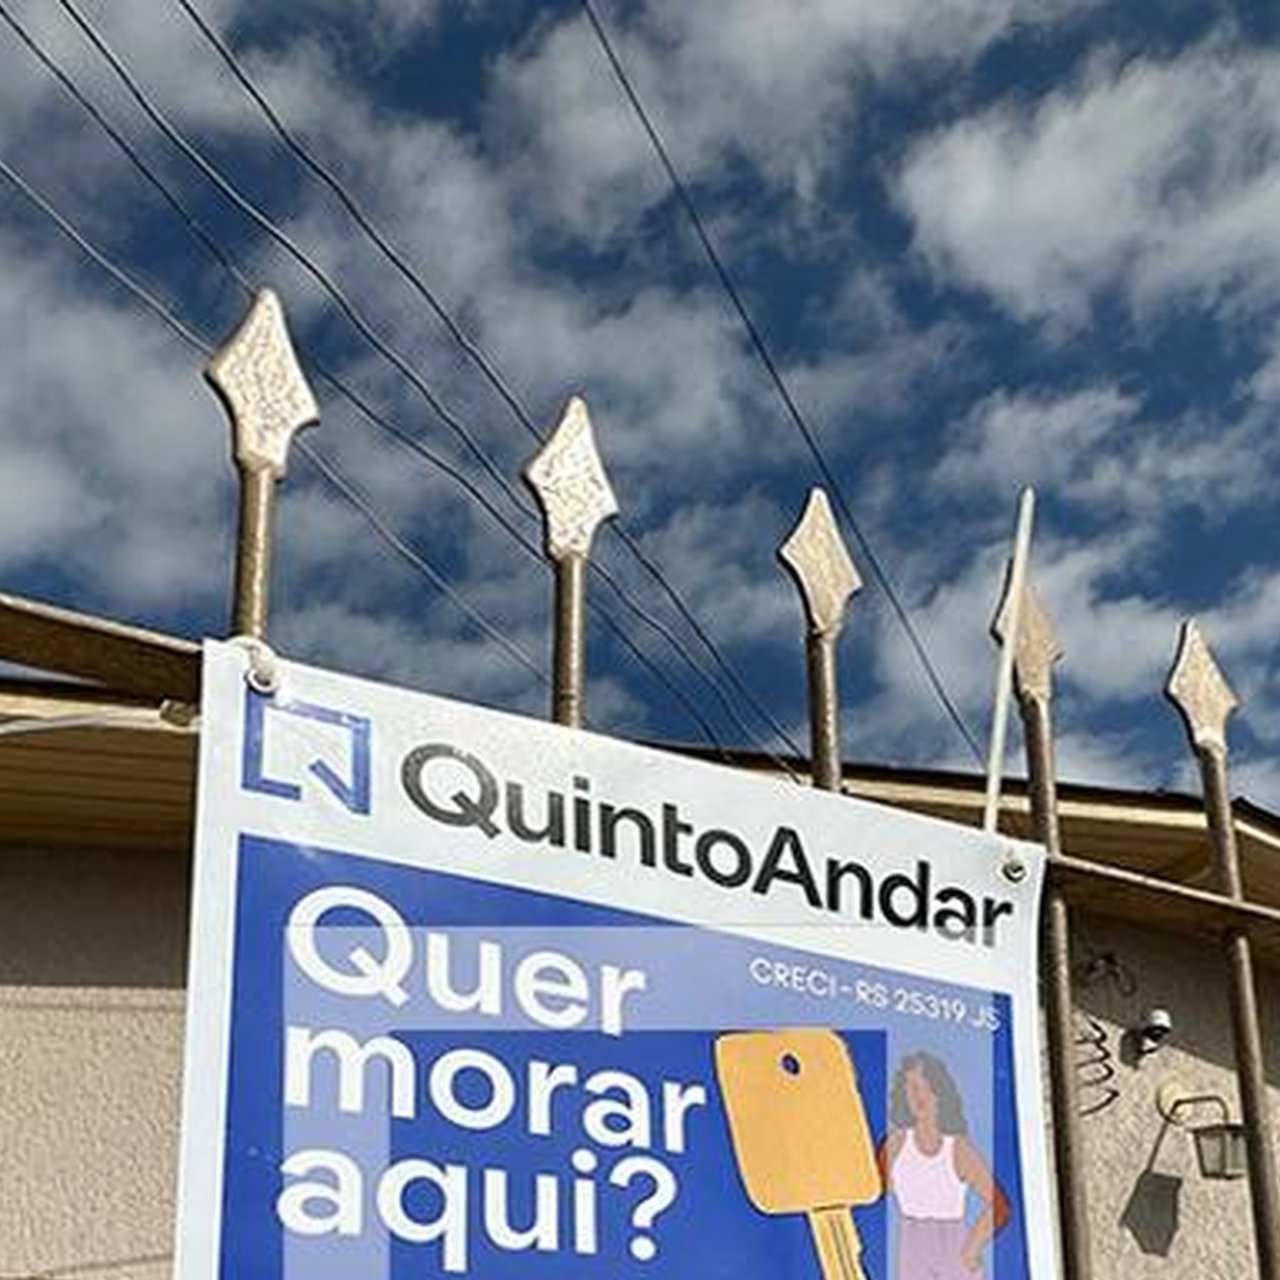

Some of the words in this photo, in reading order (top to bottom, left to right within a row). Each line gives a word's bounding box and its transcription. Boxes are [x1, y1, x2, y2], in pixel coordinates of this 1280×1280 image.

[400, 742, 1014, 949] QuintoAndar
[286, 886, 648, 1038] Quer
[894, 990, 966, 1022] 25319
[971, 1007, 1002, 1032] JS
[284, 1019, 708, 1154] morar
[275, 1146, 678, 1274] aqui?
